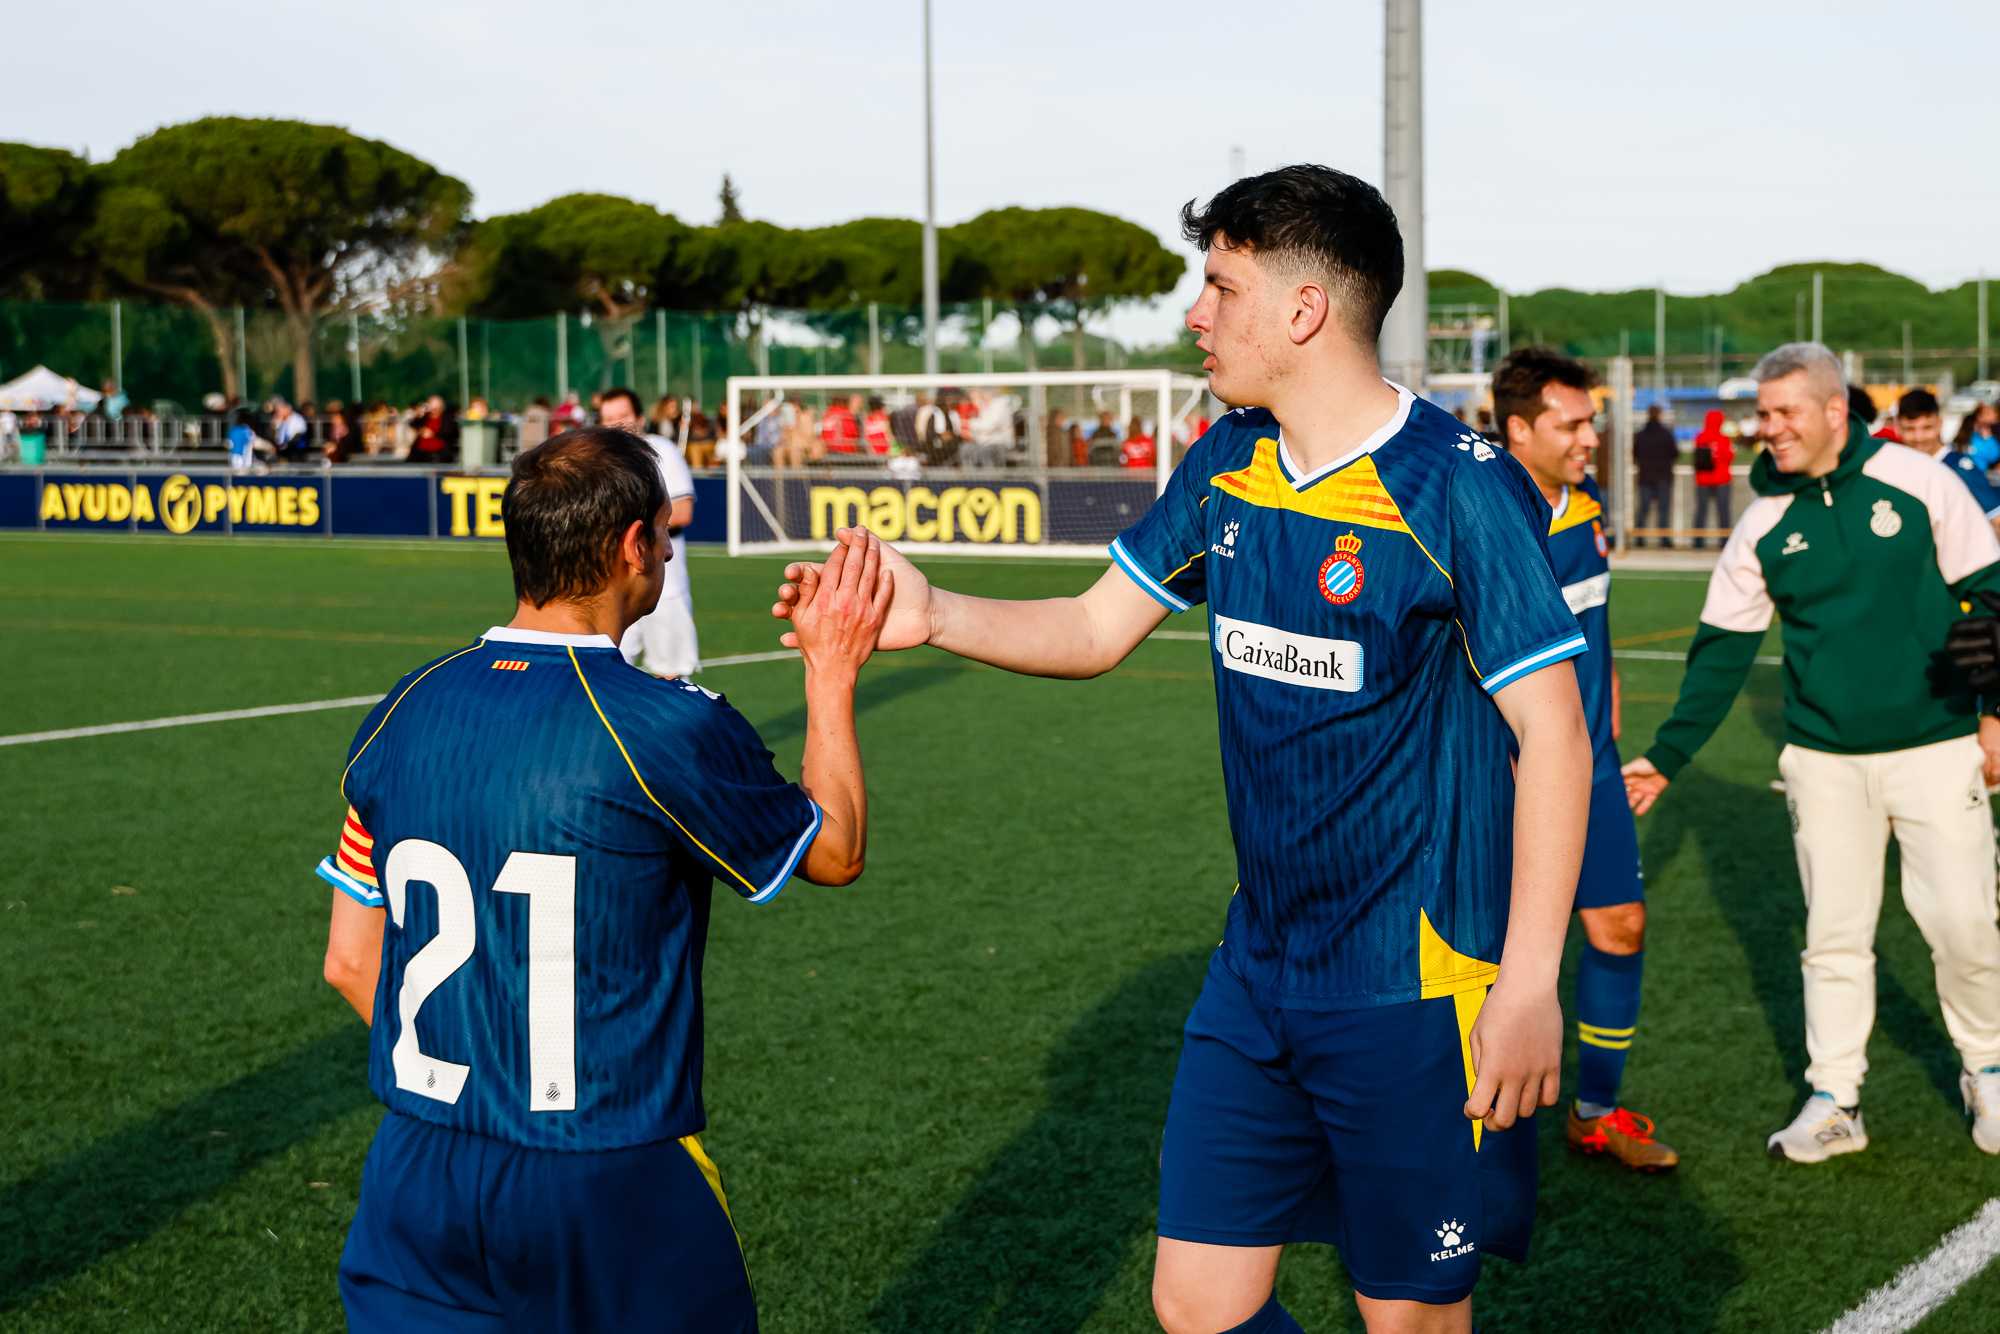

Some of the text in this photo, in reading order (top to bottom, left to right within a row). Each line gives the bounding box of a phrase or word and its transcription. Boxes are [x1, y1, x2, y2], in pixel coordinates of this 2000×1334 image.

[40, 483, 155, 522] AYUDA
[203, 485, 320, 526] PYMES
[810, 485, 1041, 544] macron
[1211, 543, 1235, 559] KELM
[1226, 630, 1345, 681] CaixaBank
[385, 838, 577, 1112] 21
[1430, 1242, 1475, 1262] KELME
